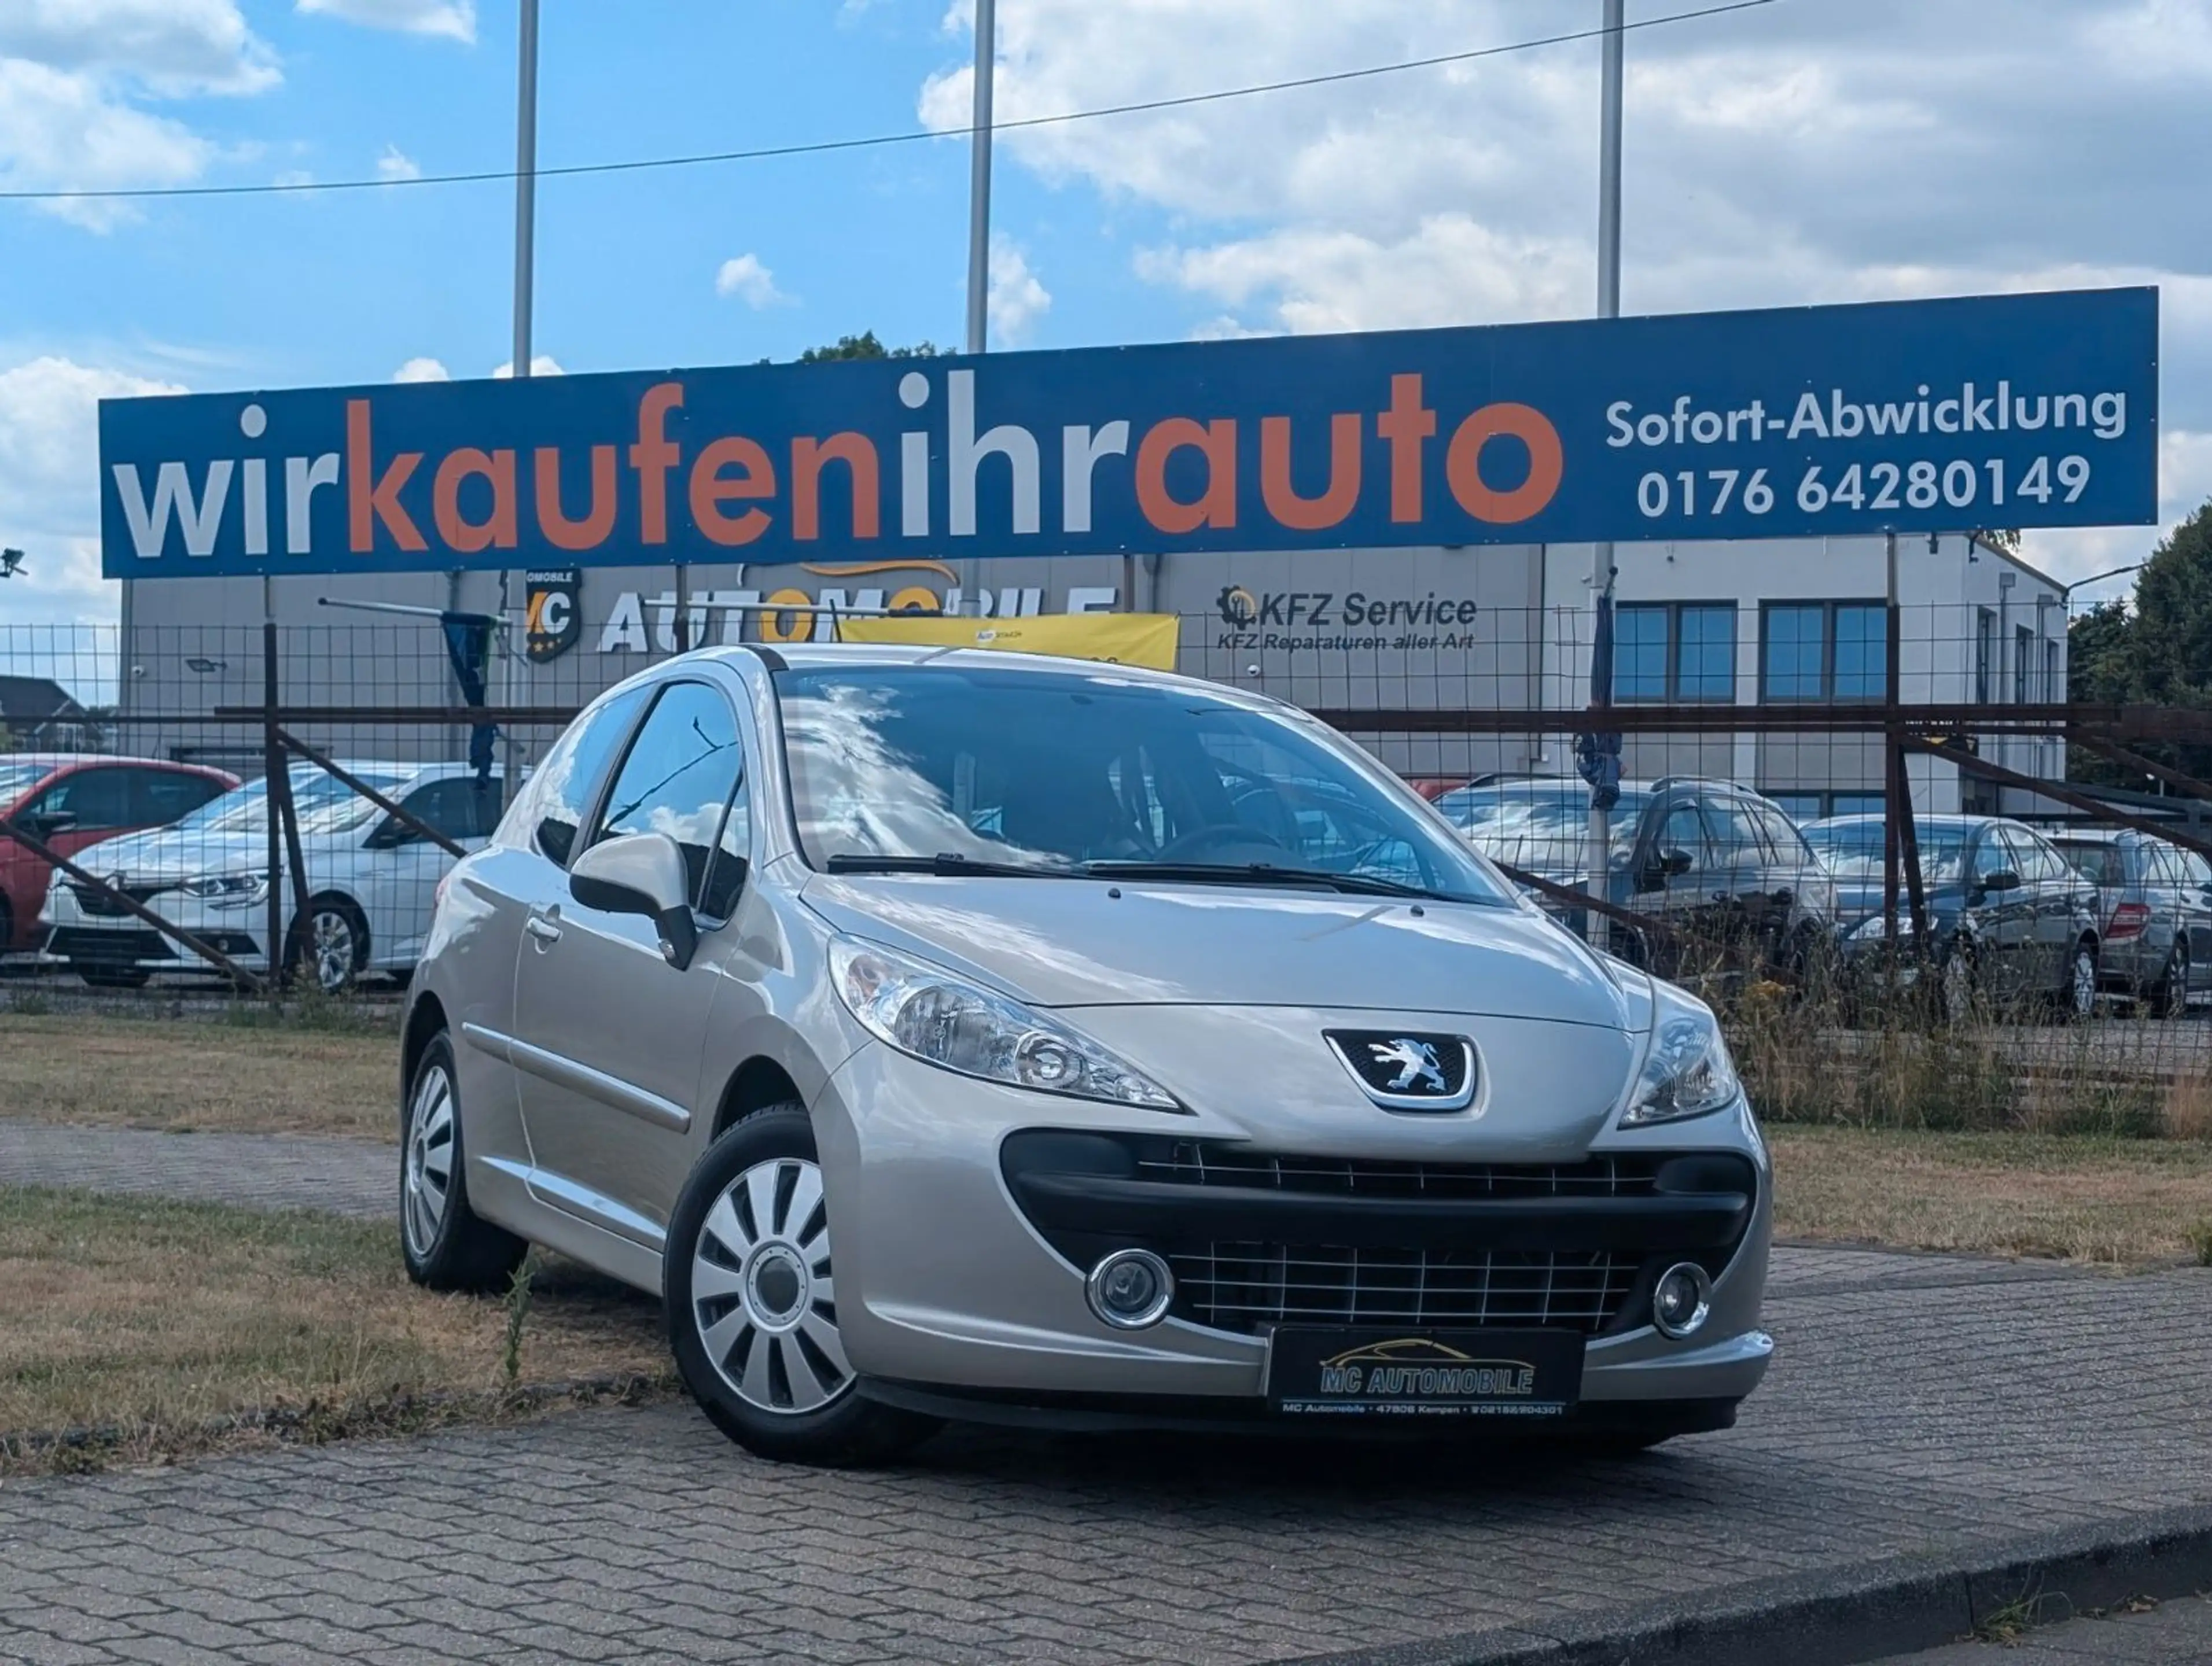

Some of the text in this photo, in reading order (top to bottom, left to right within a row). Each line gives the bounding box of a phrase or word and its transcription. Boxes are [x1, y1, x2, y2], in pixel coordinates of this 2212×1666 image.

[1606, 380, 2126, 447] Sofort-Abwicklung
[1637, 455, 2090, 518] 0176 64280149
[526, 572, 573, 583] OMOBILE
[1260, 591, 1477, 626] KFZ Service
[1217, 633, 1474, 653] KFZ Reparaturen aller Art
[1321, 1366, 1534, 1395] MC AUTOMOBILE
[1283, 1403, 1302, 1412] MC
